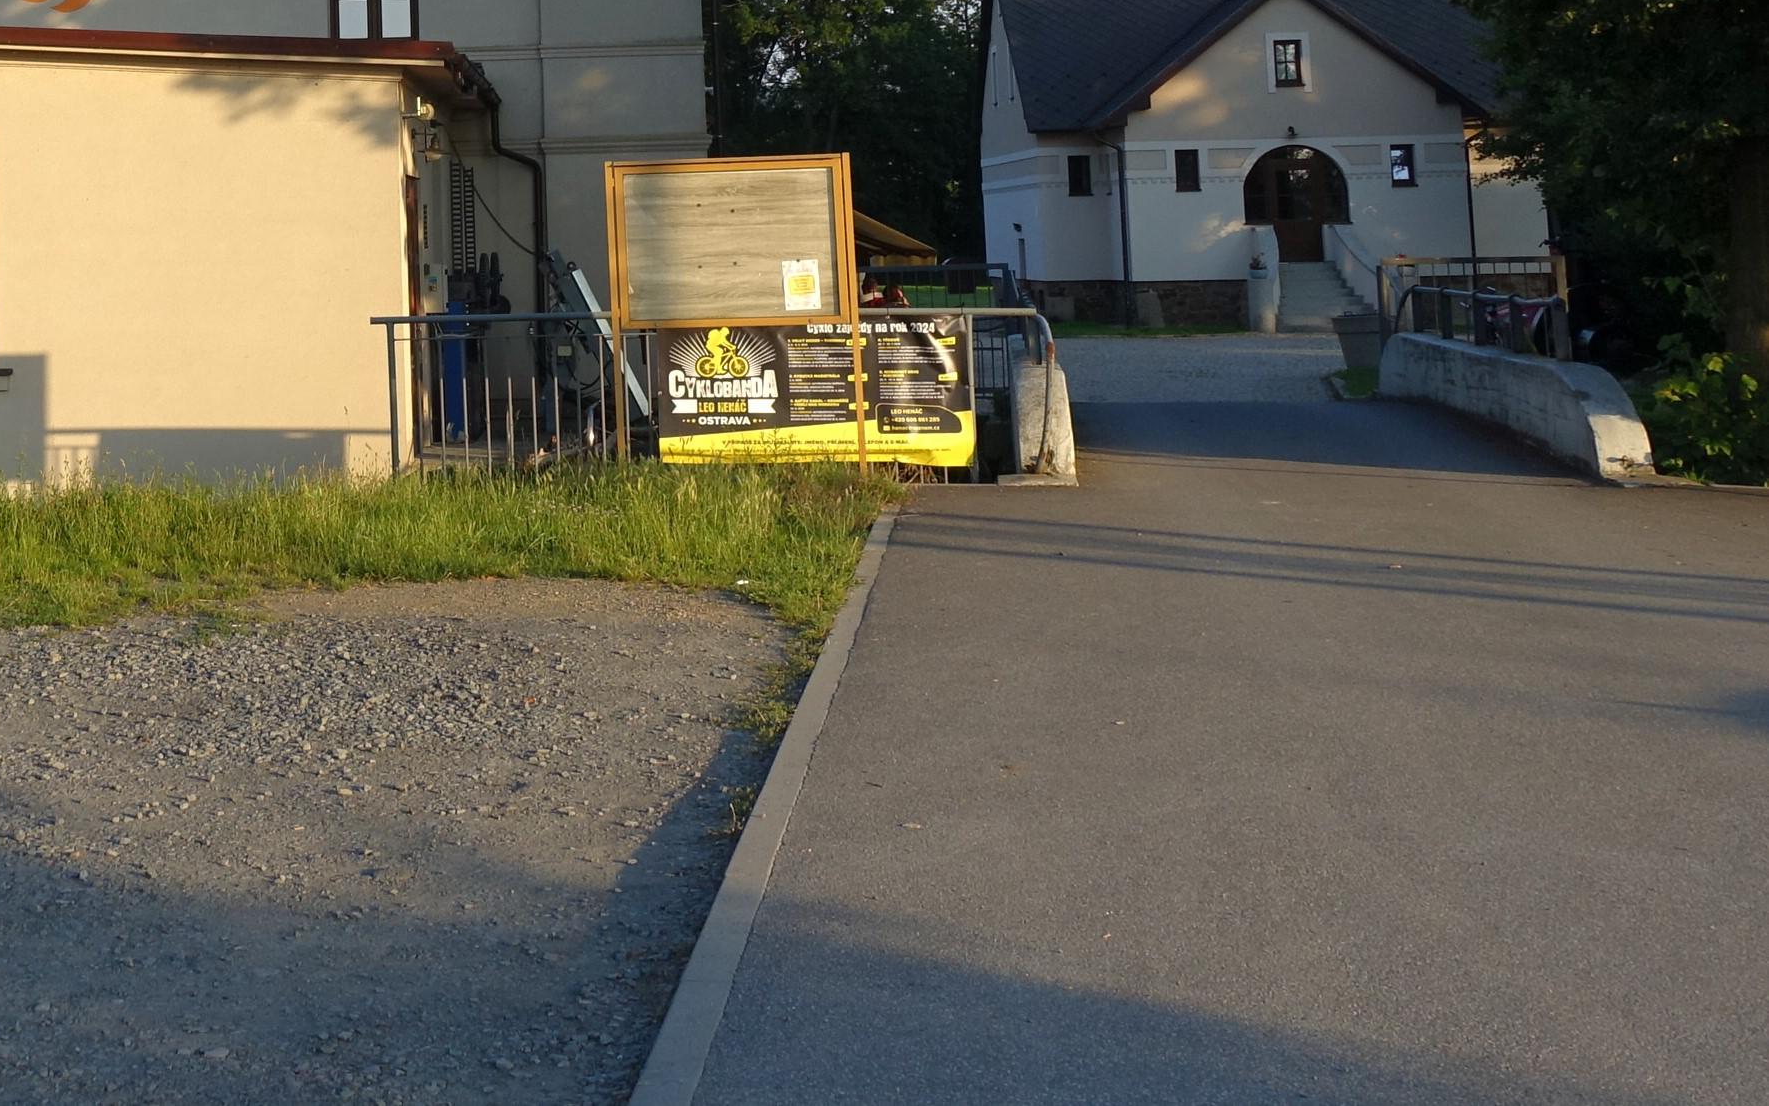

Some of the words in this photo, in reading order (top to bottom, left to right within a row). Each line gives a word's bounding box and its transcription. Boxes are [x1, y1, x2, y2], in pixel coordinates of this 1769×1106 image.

[875, 323, 888, 333] na
[889, 322, 908, 333] rok
[910, 322, 935, 333] 2024
[668, 369, 779, 398] CYKLOBANDA
[698, 402, 715, 413] LEO
[698, 416, 751, 425] OSTRAVA
